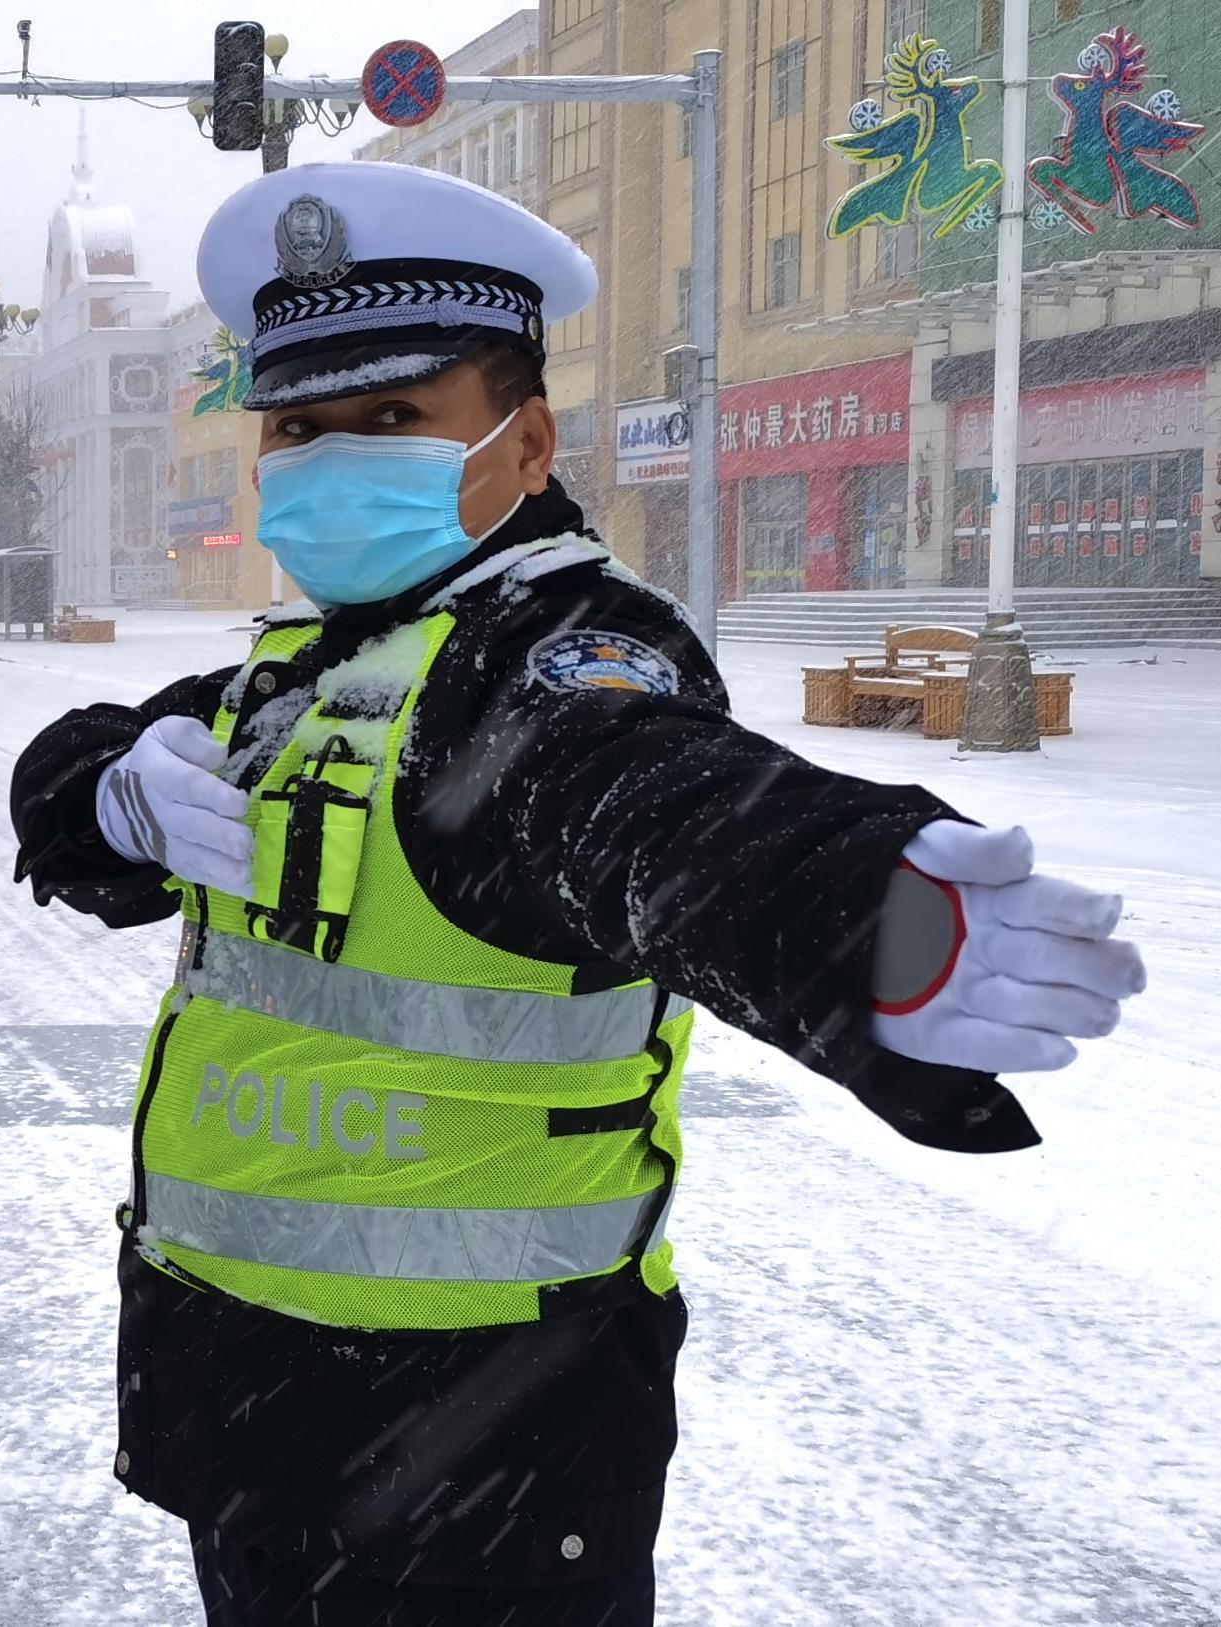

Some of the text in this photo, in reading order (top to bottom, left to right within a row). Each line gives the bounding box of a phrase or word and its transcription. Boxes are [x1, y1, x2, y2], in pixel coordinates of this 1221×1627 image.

[295, 273, 334, 287] POLICE
[720, 391, 861, 453] 张仲景大药房
[189, 1062, 428, 1161] POLICE
